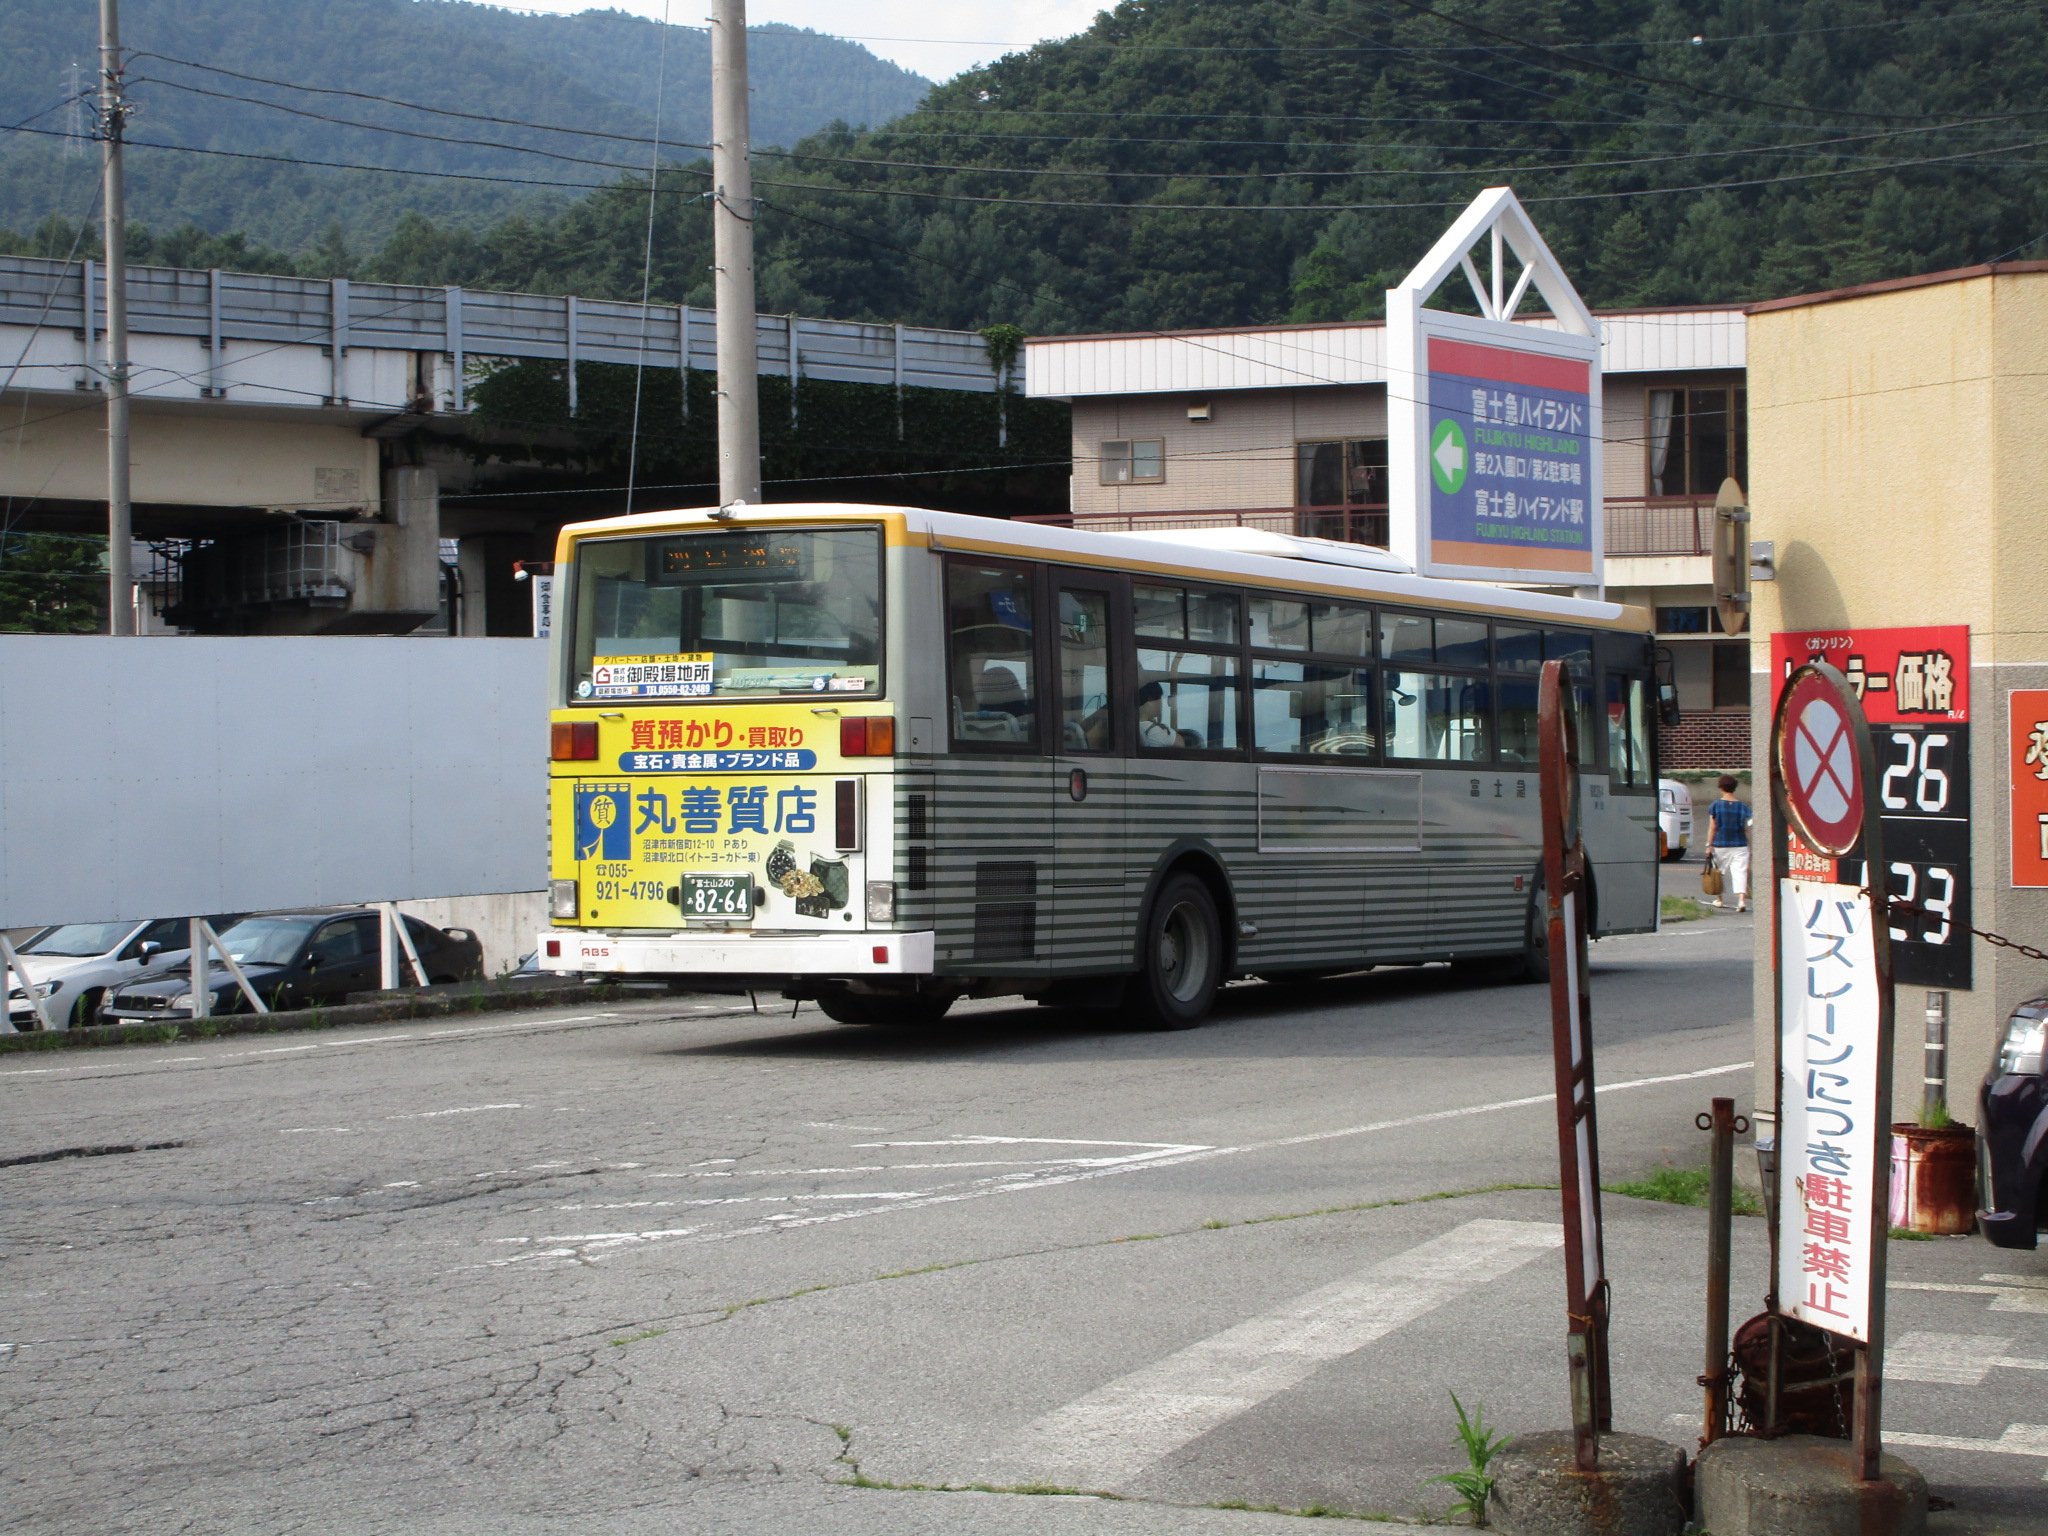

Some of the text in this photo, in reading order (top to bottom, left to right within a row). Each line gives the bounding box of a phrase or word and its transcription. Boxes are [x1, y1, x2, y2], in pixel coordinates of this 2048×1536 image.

[1472, 388, 1582, 434] 富士急ハイランド
[1474, 428, 1580, 455] FUJIKYU HIGHLAND
[1475, 489, 1584, 524] 富士急ハイランド駅
[1476, 522, 1583, 544] FUJIKYU HIGHLAND STATION
[627, 664, 710, 684] 御殿場地所
[630, 719, 804, 750] 質預かり・買取り
[633, 752, 800, 769] 宝石・貴金属・ブランド品
[593, 797, 614, 825] 質
[635, 785, 817, 835] 丸善質店
[643, 839, 748, 850] 沼津市新宿町12-10 Pあり
[596, 880, 664, 901] 921-4796
[695, 889, 748, 912] 82-64
[581, 948, 609, 957] ABS
